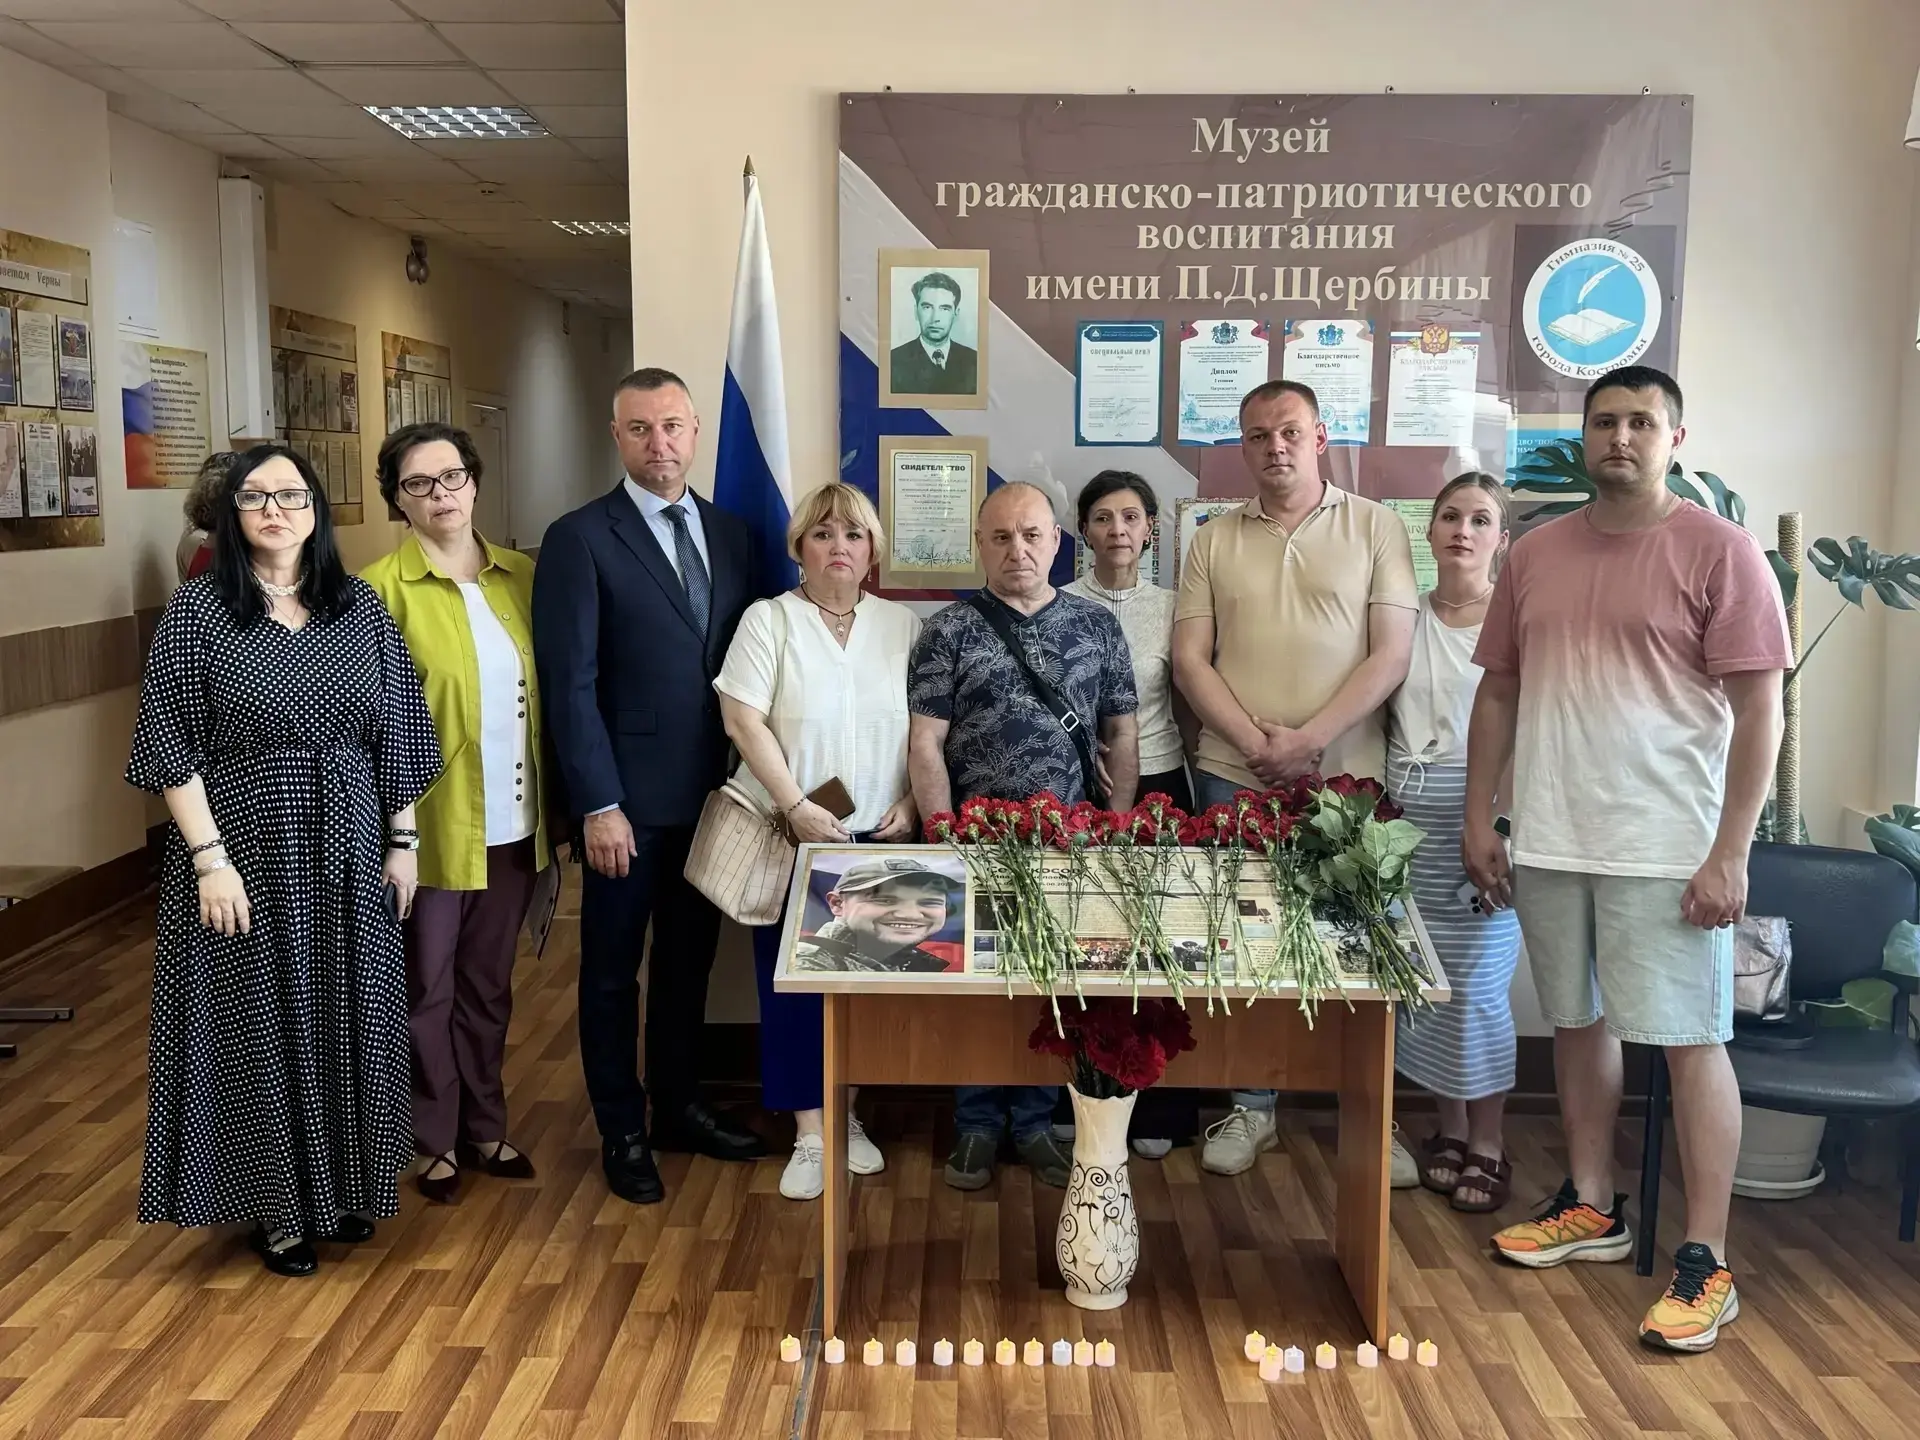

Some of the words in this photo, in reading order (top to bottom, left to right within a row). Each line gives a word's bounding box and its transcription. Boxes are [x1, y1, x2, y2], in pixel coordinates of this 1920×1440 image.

[1191, 117, 1331, 164] Музей
[935, 181, 1592, 219] гражданско-патриотического
[1136, 223, 1396, 250] воспитания
[1545, 243, 1615, 272] Гимназия
[1629, 256, 1645, 272] 25
[1025, 274, 1161, 301] имени
[1174, 264, 1492, 311] П.Д.Щербины
[1297, 352, 1360, 360] Благодарственное
[1531, 335, 1572, 373] города
[1575, 338, 1648, 376] Костромы
[900, 464, 966, 472] СВИДЕТЕЛЬТВО
